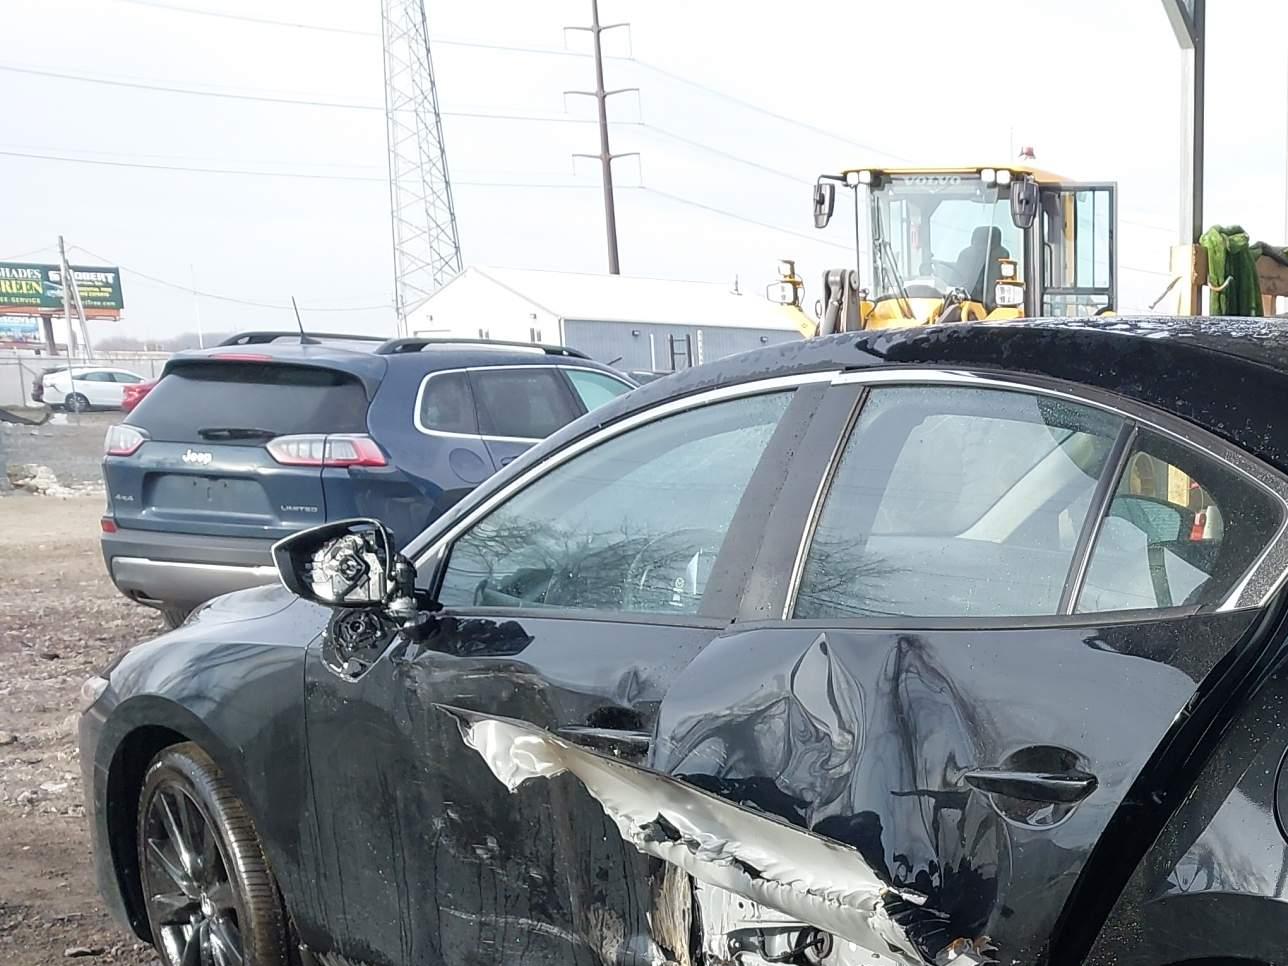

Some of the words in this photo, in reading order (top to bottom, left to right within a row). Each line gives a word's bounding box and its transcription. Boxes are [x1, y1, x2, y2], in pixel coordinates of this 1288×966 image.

[904, 175, 961, 186] VOLVO
[0, 267, 41, 279] HADES
[0, 279, 43, 294] REEN
[182, 448, 212, 465] Jeep
[280, 504, 318, 513] LIMITED
